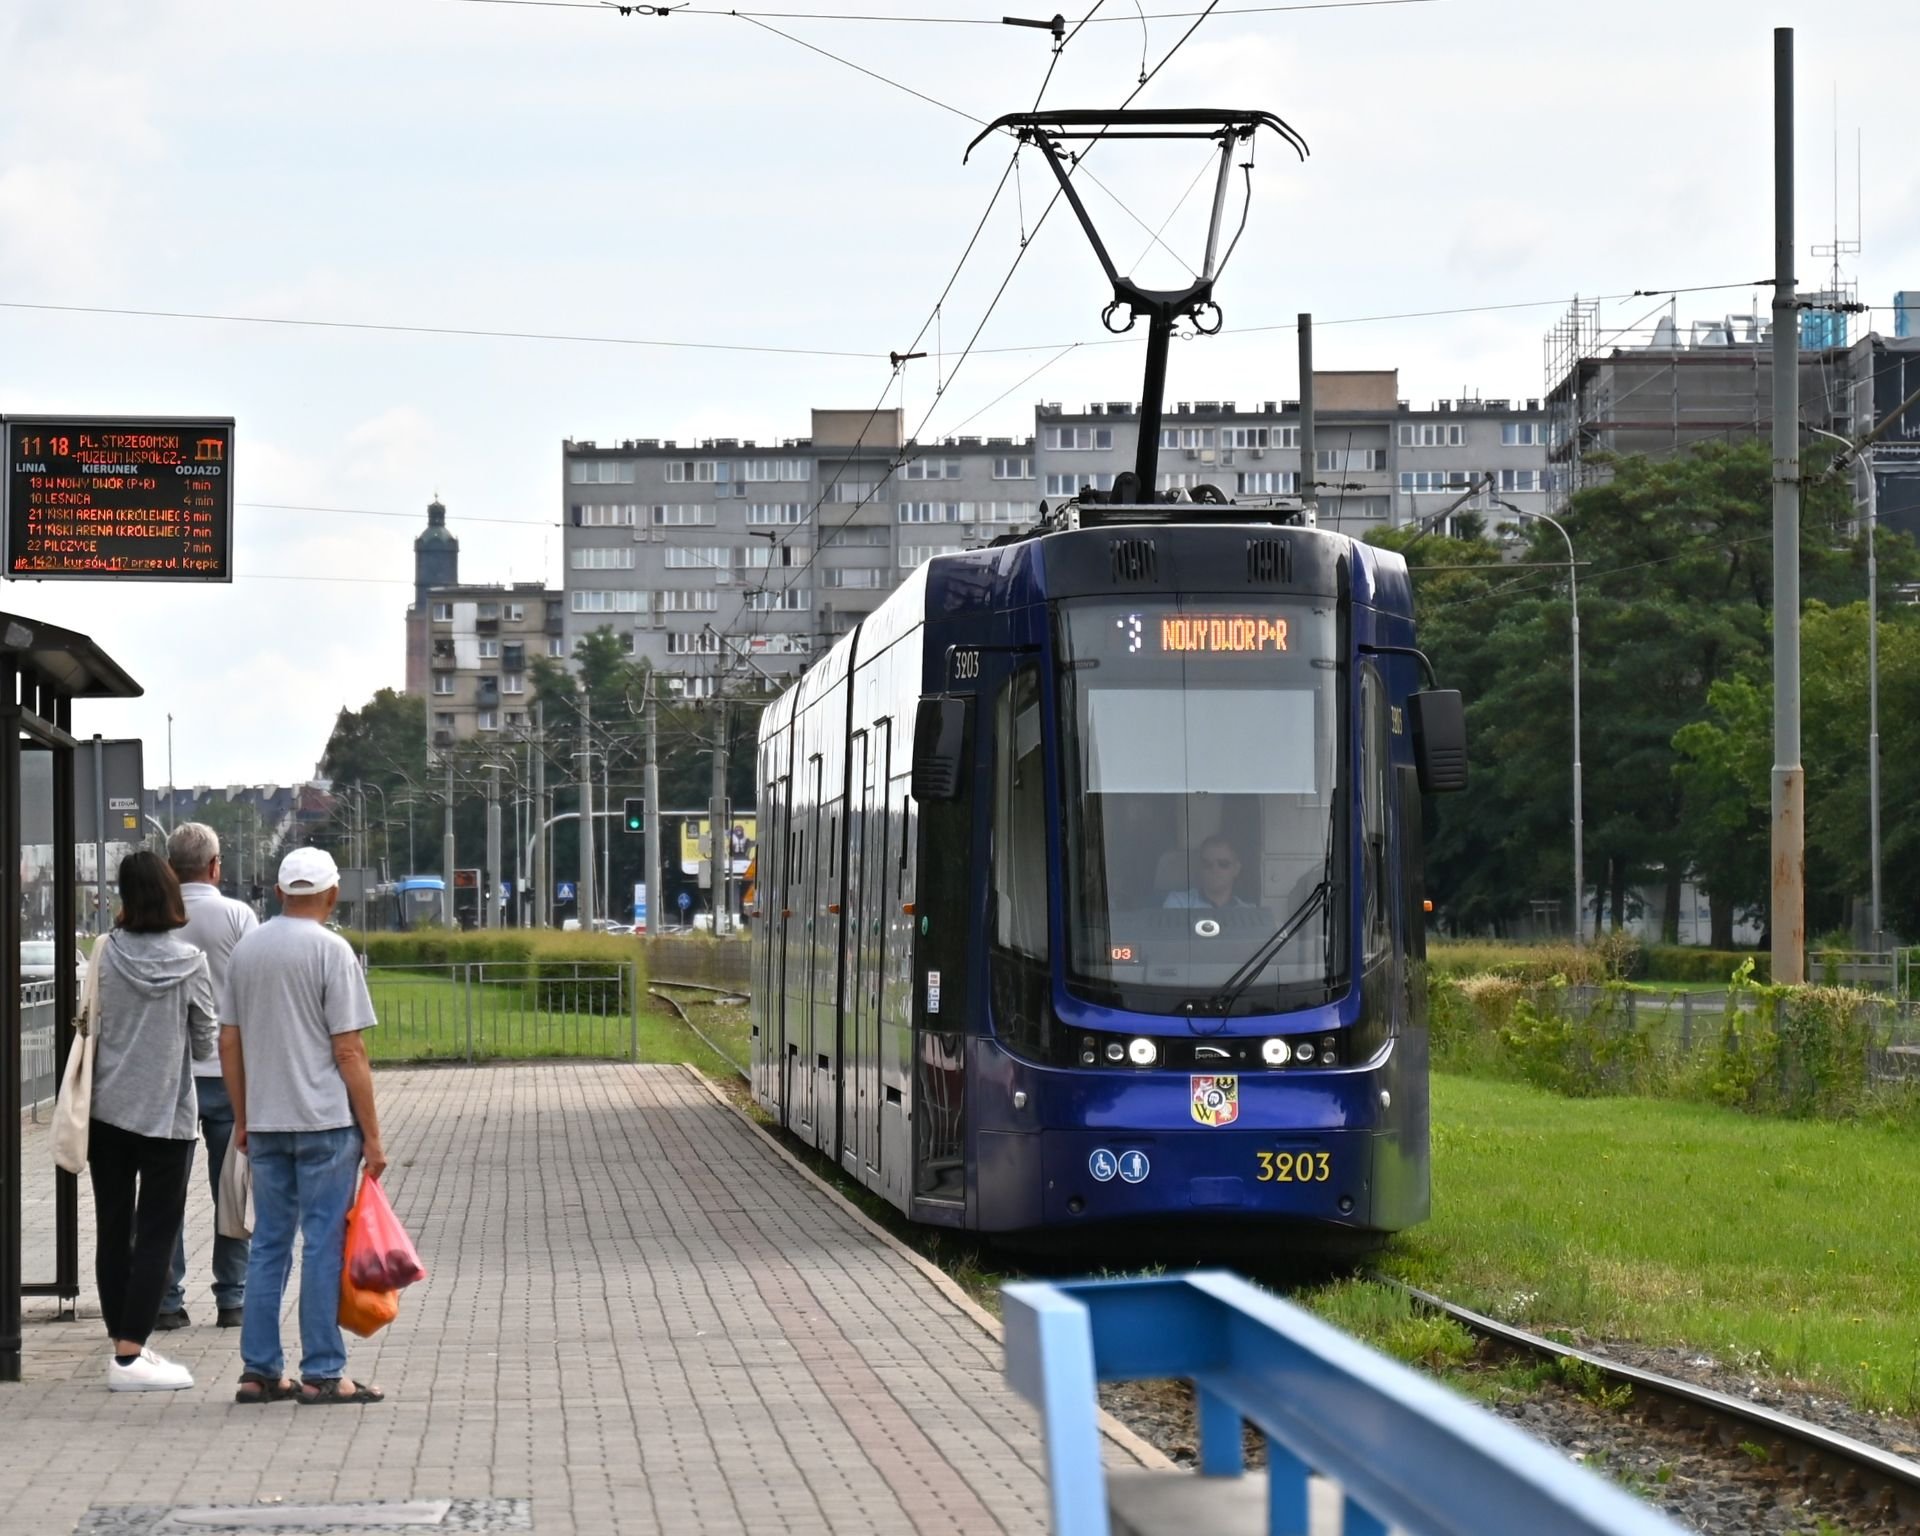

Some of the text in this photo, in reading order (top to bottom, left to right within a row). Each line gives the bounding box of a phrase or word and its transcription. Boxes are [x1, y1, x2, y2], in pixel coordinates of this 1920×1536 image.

[21, 437, 69, 456] 11 18
[80, 434, 179, 449] PL. STRZEGOMSKI
[16, 463, 221, 475] LINIA KIERUNEK ODJAZD
[30, 477, 42, 489] 13
[56, 477, 89, 489] NOWY
[92, 477, 124, 489] DWÓR
[192, 480, 211, 491] min
[45, 492, 91, 505] LEŚNICA
[195, 495, 214, 506] min
[29, 508, 42, 520] 21
[76, 508, 113, 521] ARENA
[193, 510, 212, 522] min
[76, 524, 113, 536] ARENA
[183, 526, 190, 537] 7
[193, 526, 212, 537] min
[27, 540, 211, 553] 22 PILCZYCE 7 min
[64, 554, 106, 569] kursów
[110, 557, 128, 569] 117
[131, 559, 162, 571] przez
[1163, 619, 1207, 650] NOWY
[1112, 948, 1131, 960] 03
